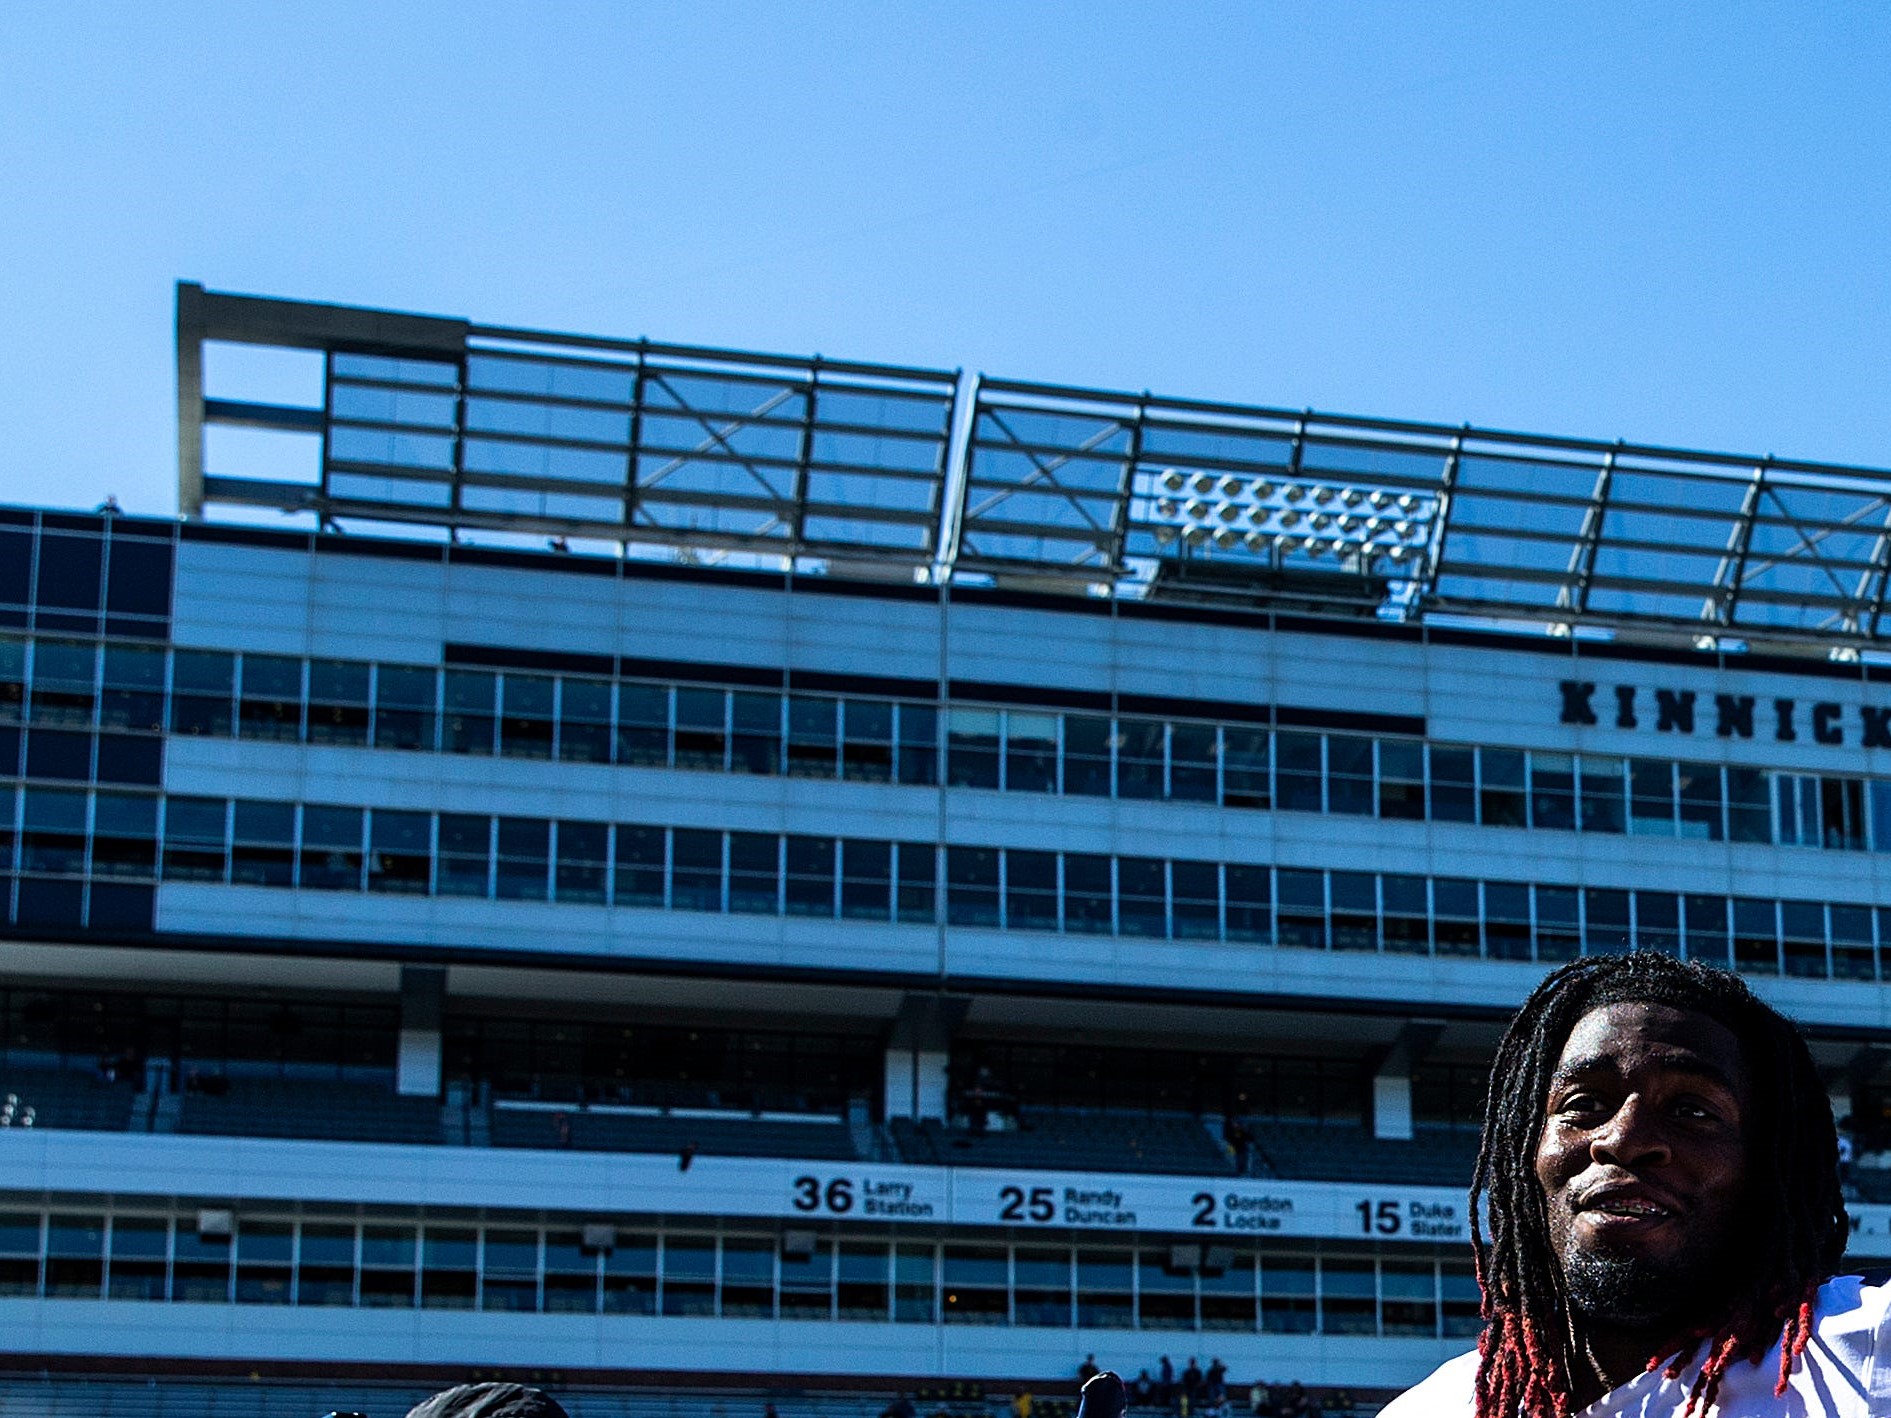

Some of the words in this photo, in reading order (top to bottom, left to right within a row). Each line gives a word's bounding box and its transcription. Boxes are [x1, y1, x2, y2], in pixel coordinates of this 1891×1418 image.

[793, 1177, 854, 1213] 36
[1000, 1186, 1056, 1222] 25
[1063, 1187, 1124, 1209] Randy
[1191, 1192, 1217, 1227] 2
[1064, 1207, 1137, 1225] Duncan
[1355, 1199, 1401, 1234] 15
